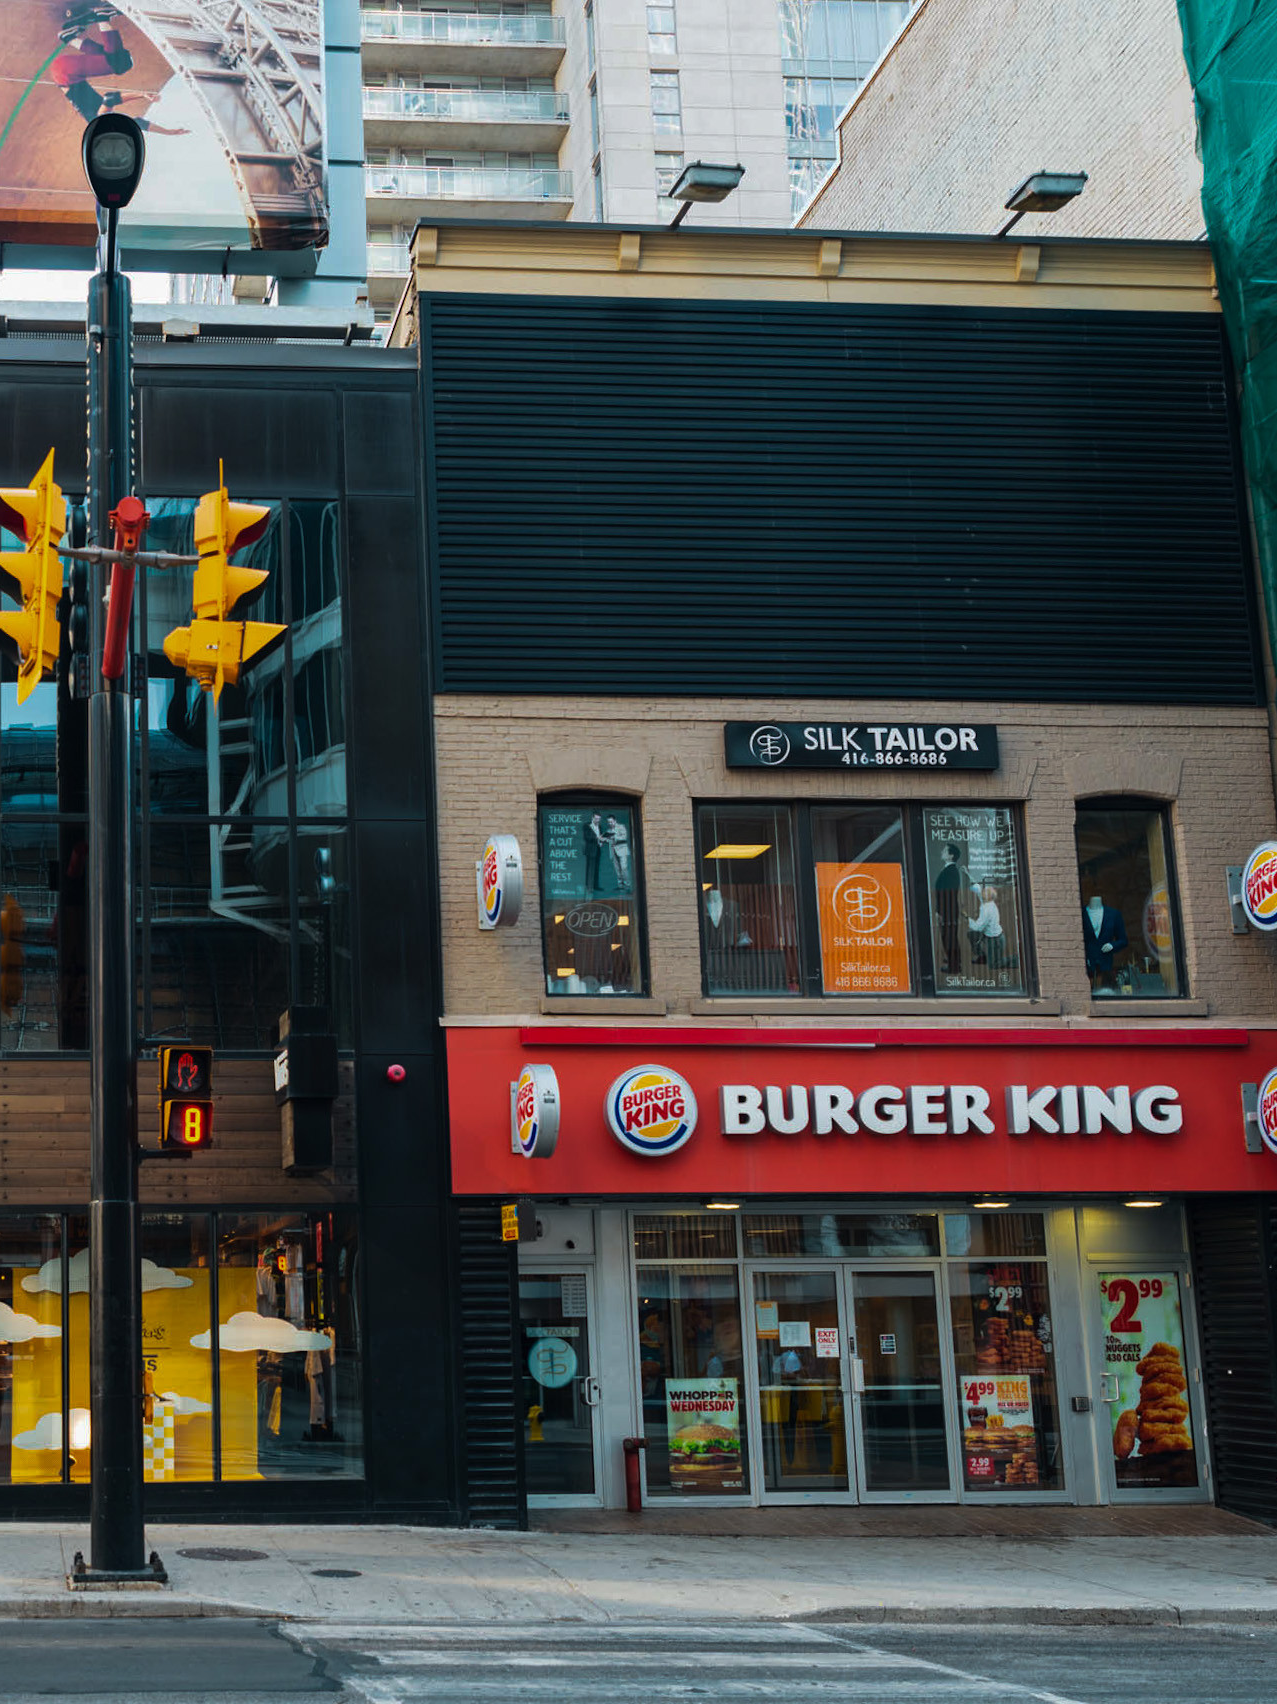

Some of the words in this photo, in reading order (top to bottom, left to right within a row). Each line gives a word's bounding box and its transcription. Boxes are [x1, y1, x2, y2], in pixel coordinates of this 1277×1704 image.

[803, 727, 863, 750] SILK
[867, 727, 979, 751] TAILOR
[841, 752, 947, 765] 416-866-8686
[548, 814, 583, 824] SERVICE
[930, 814, 952, 827] SEE
[955, 815, 981, 827] HOW
[985, 815, 1005, 828] WE
[549, 826, 578, 835] THAT'S
[931, 829, 986, 842] MEASURE
[989, 830, 1005, 842] UP
[549, 838, 556, 847] A
[556, 838, 574, 847] CUT
[549, 849, 578, 859] ABOVE
[551, 861, 567, 870] THE
[550, 873, 572, 882] REST
[568, 911, 614, 928] OPEN
[834, 936, 854, 947] SILK
[855, 936, 894, 947] TAILOR
[946, 975, 996, 988] SilkTailor.ca
[622, 1084, 682, 1112] BURGER
[625, 1098, 686, 1132] KING
[721, 1085, 995, 1134] BURGER
[1008, 1085, 1183, 1134] KING
[185, 1107, 201, 1142] 8
[817, 1330, 836, 1338] EXIT
[1106, 1344, 1141, 1353] NUGGETS
[1106, 1353, 1122, 1363] 430
[1122, 1353, 1141, 1363] CALS
[670, 1400, 736, 1413] WEDNESDAY
[971, 1457, 990, 1467] 2.99
